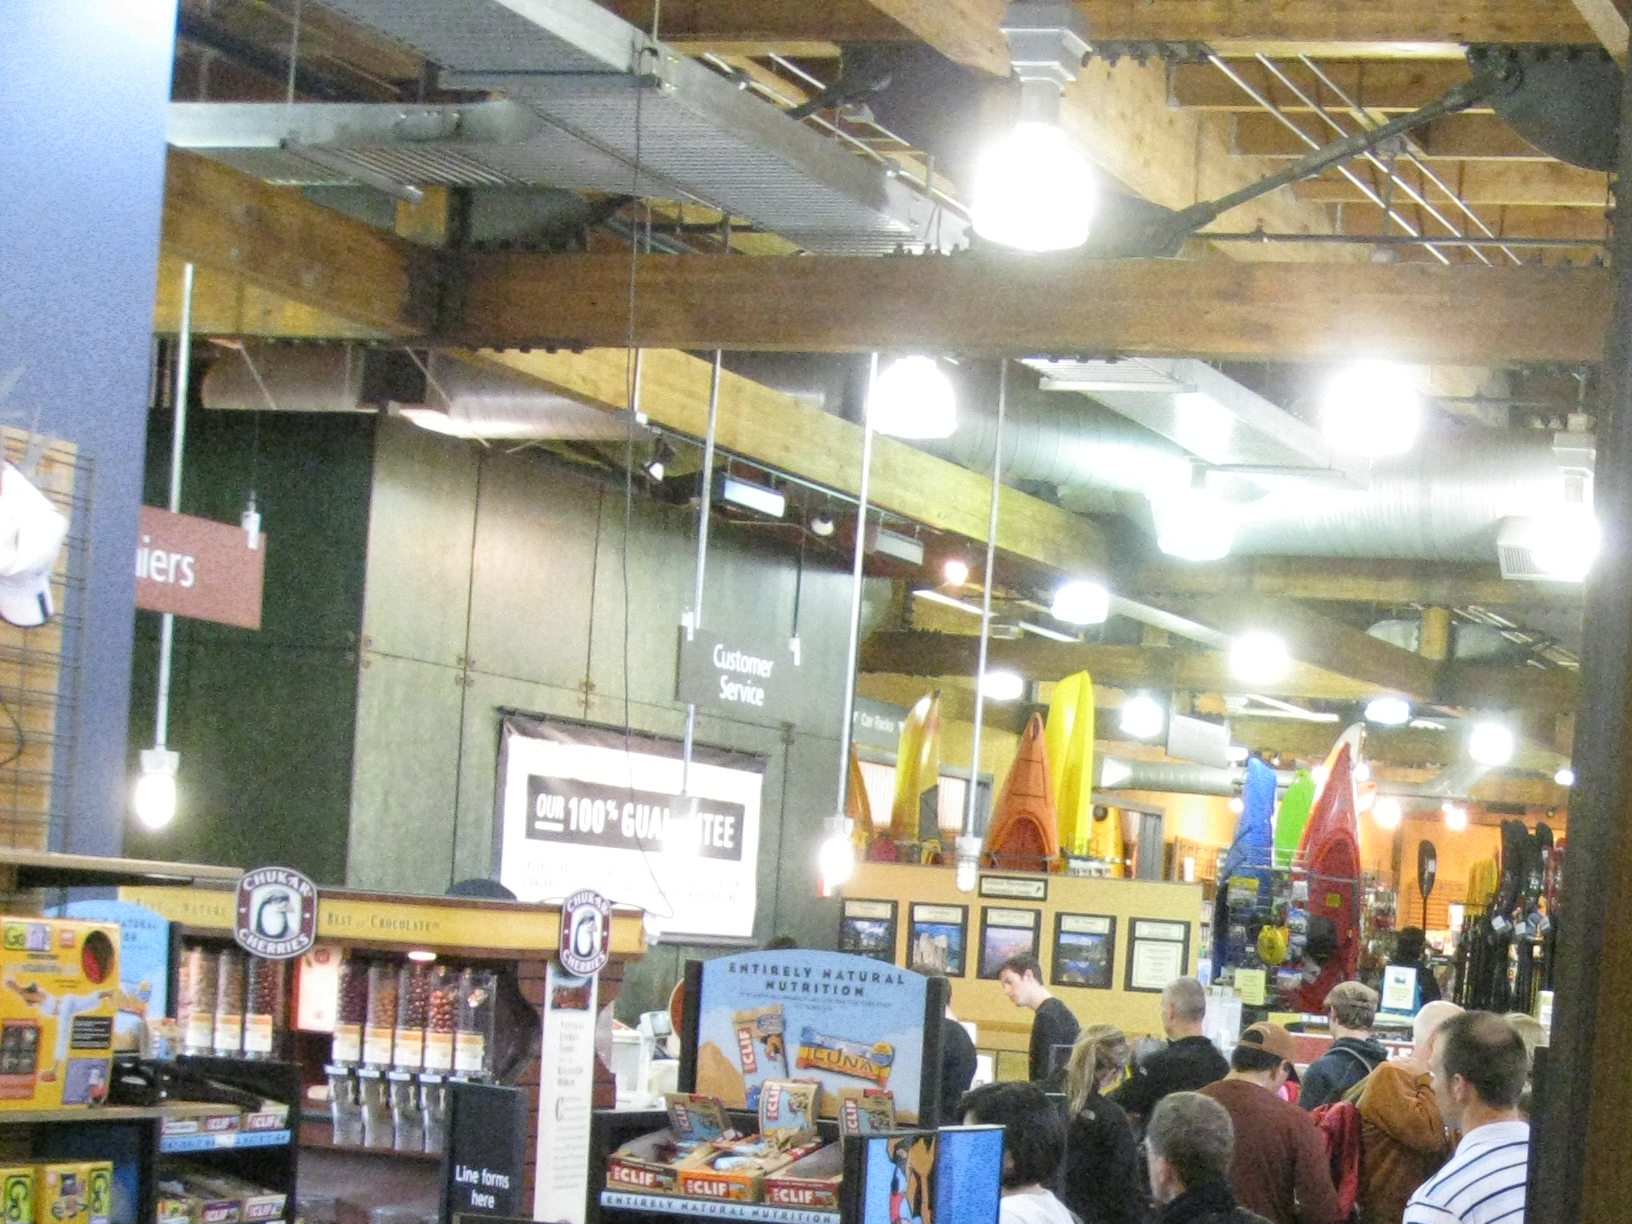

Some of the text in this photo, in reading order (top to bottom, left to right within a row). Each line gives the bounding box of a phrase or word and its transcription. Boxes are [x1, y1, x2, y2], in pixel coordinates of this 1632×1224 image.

[713, 643, 775, 678] Customer
[719, 674, 765, 707] Service
[535, 792, 736, 849] OUR 100% GUATEE
[243, 870, 313, 899] CHUKAR
[566, 890, 608, 914] CHUKAR
[238, 927, 310, 956] CHERRIES
[562, 949, 607, 974] CHERRIES
[727, 962, 906, 986] ENTIRELY NATURAL
[765, 979, 867, 997] NUTRITION
[739, 1029, 754, 1066] CLIF
[810, 1047, 876, 1074] LUNA
[768, 1083, 782, 1114] CLIF
[845, 1100, 858, 1130] CLIF
[455, 1164, 510, 1190] Line forms
[621, 1170, 655, 1187] CLIF
[693, 1181, 728, 1196] CLIF
[470, 1188, 495, 1209] here
[606, 1195, 832, 1224] ENTIRELY NATURAL NUTRITION
[778, 1190, 814, 1206] CLIF
